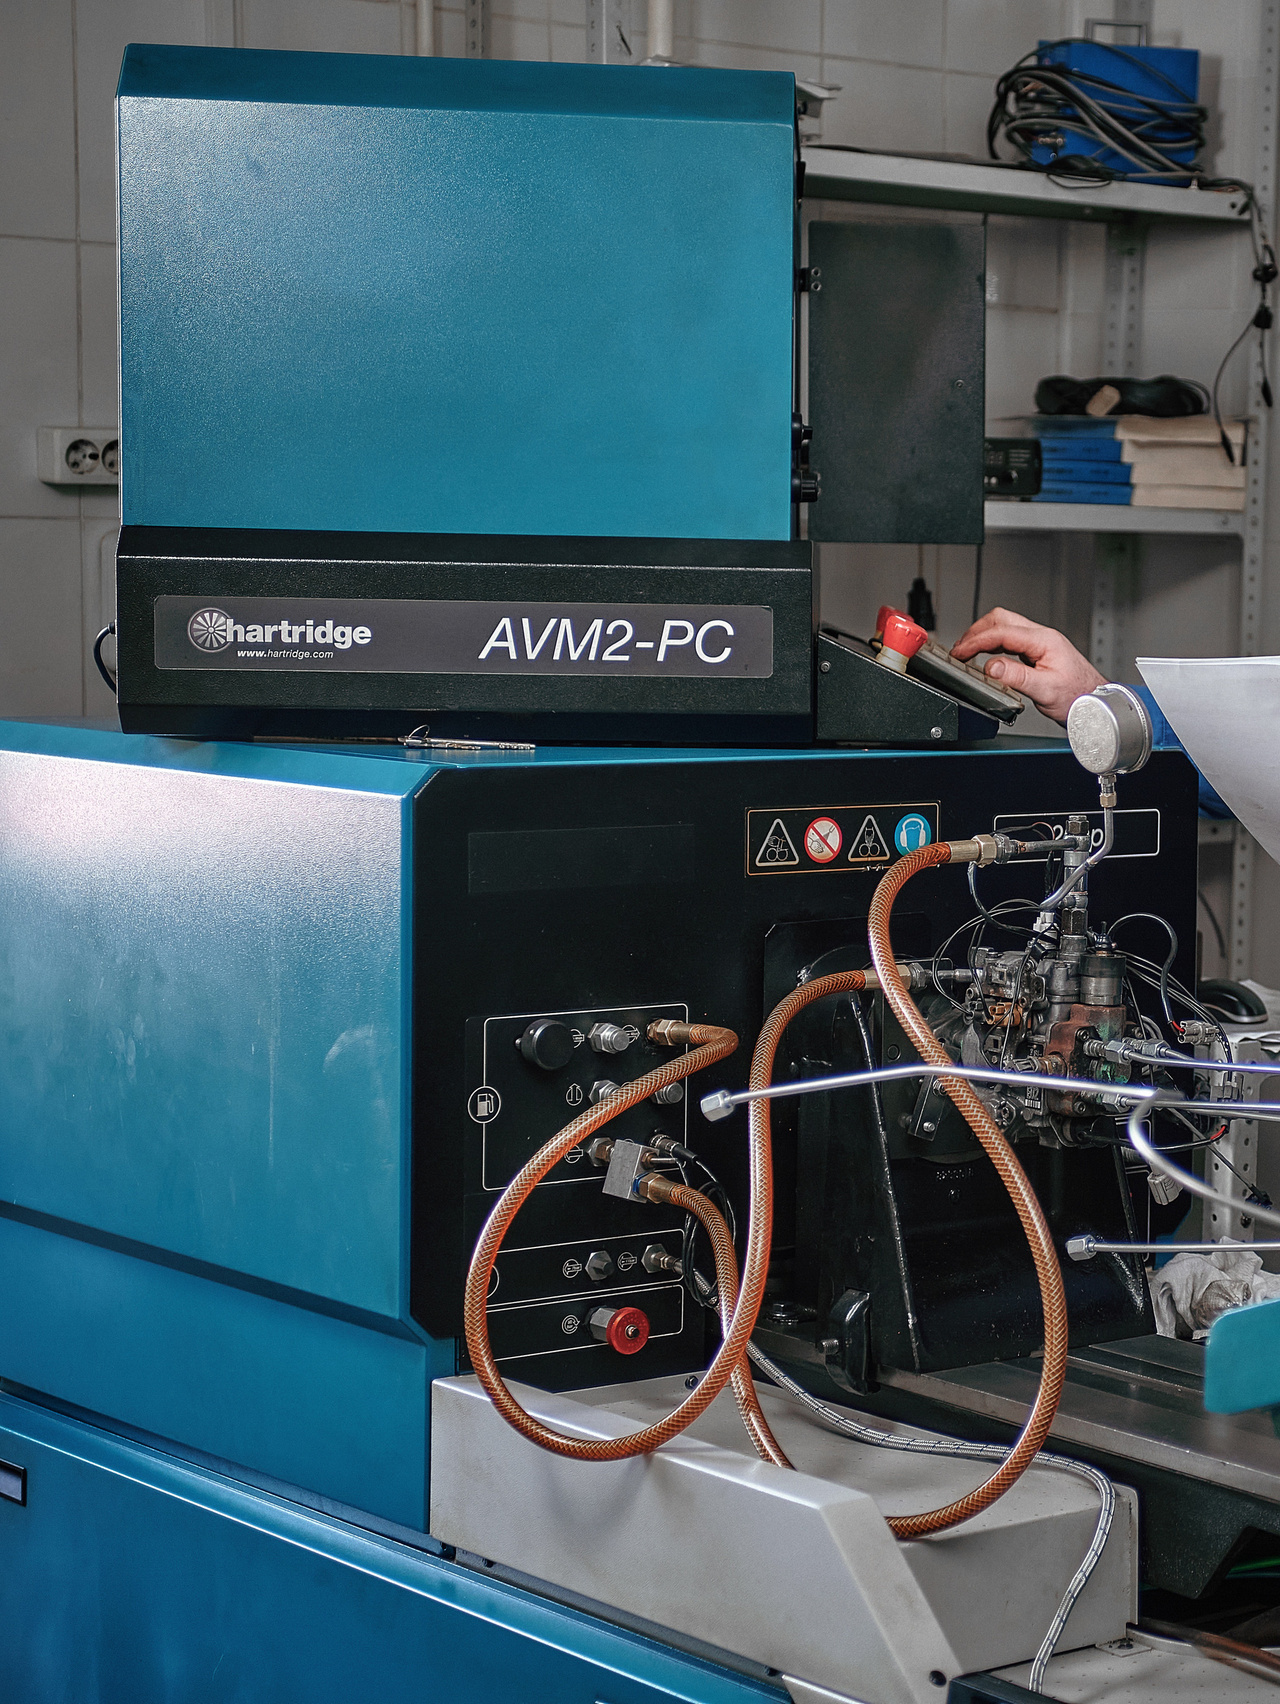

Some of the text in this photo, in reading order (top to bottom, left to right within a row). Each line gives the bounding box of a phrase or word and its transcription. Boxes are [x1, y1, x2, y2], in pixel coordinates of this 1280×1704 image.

[226, 618, 372, 650] hartridge
[479, 617, 735, 664] AVM2-PC
[237, 648, 334, 660] www.hartridge.com
